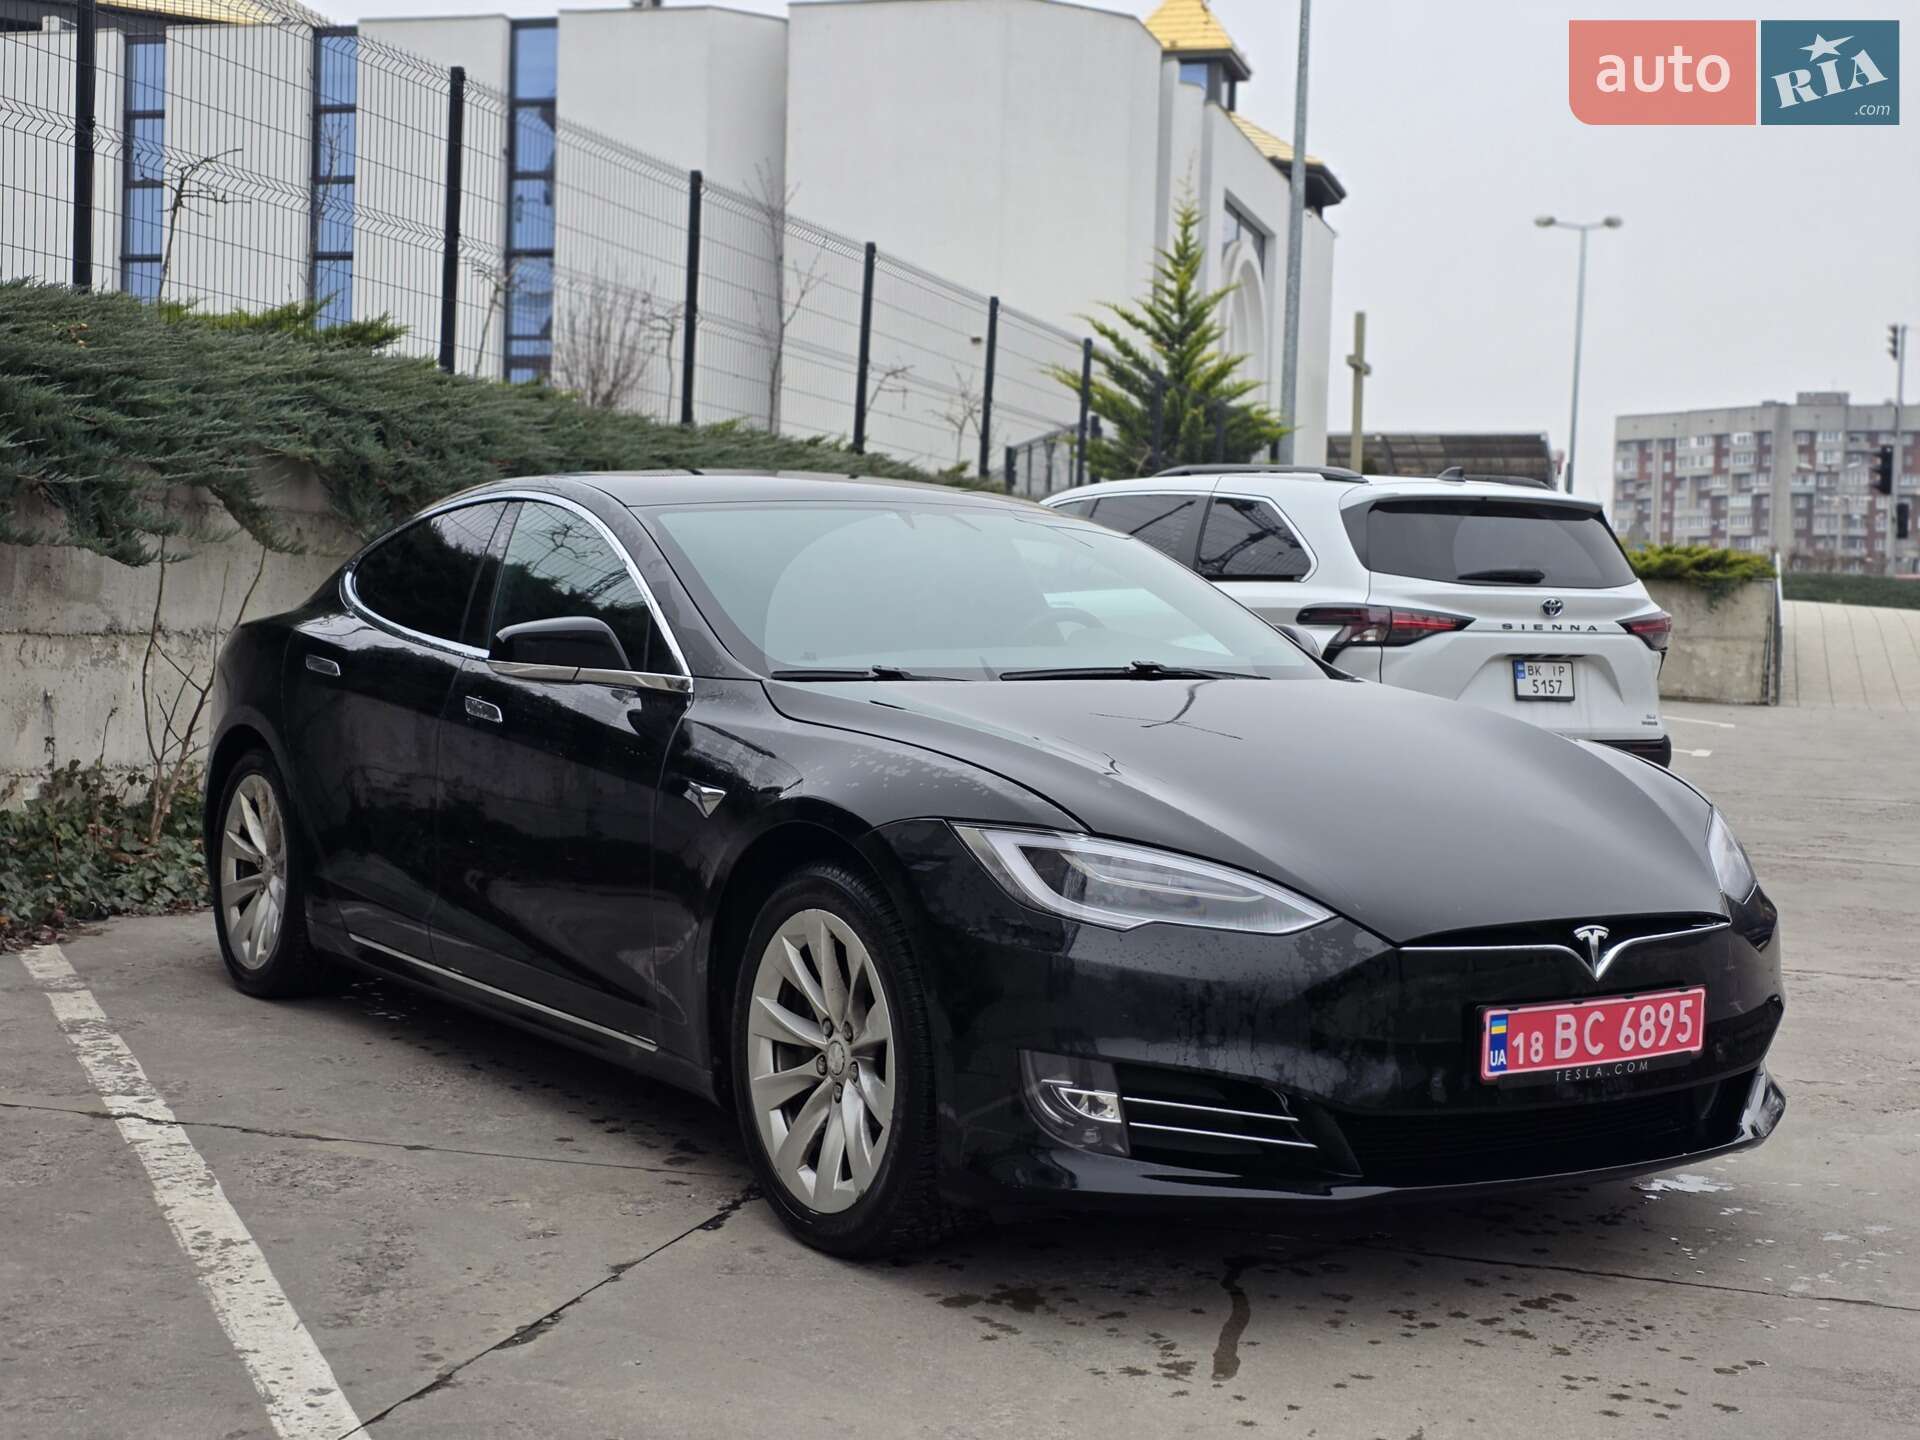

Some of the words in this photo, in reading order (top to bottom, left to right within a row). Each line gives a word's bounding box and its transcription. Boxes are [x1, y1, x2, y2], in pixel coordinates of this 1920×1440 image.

[1502, 623, 1598, 631] SIENNA
[1527, 665, 1542, 676] BK
[1552, 665, 1565, 676] IP
[1532, 680, 1562, 694] 5157
[1511, 1031, 1544, 1065] 18
[1554, 1011, 1606, 1060] BC
[1618, 999, 1693, 1051] 6895
[1489, 1050, 1507, 1067] UA
[1555, 1060, 1649, 1083] TESLA.COM
